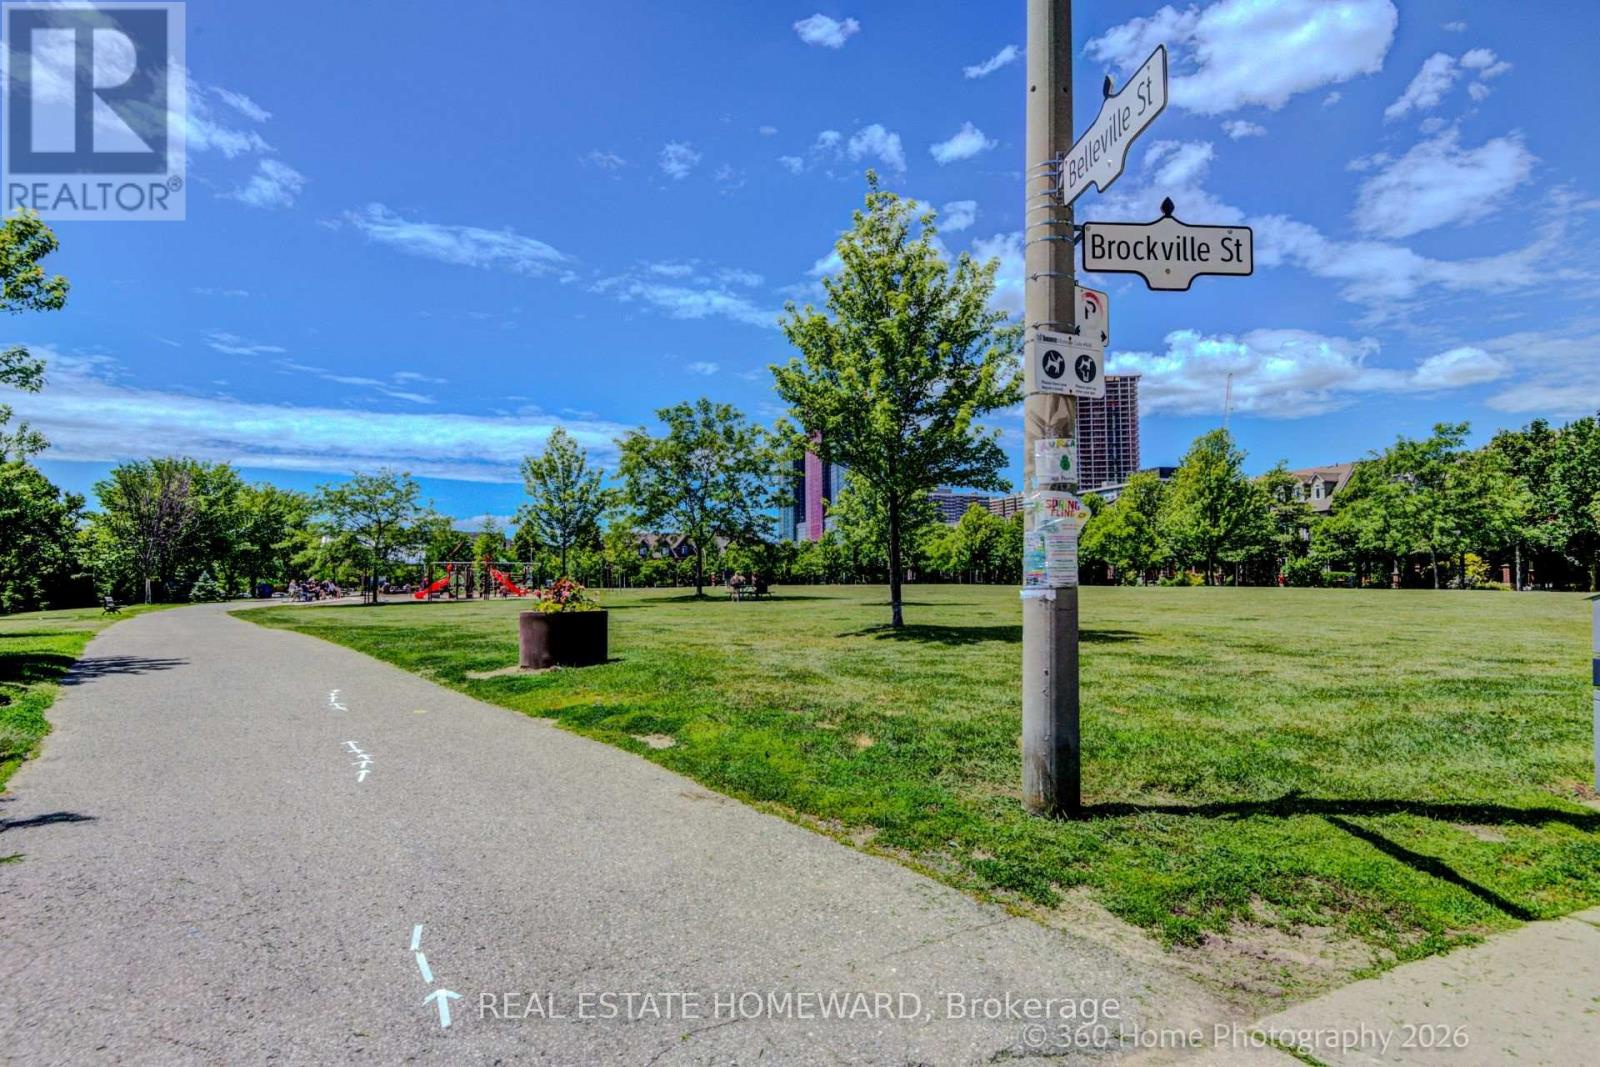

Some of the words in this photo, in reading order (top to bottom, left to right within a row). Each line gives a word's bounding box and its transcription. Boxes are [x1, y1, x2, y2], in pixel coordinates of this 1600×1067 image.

[1069, 103, 1131, 189] Belleville
[1137, 76, 1153, 117] St
[1091, 233, 1210, 263] Brockville
[1221, 237, 1243, 263] St
